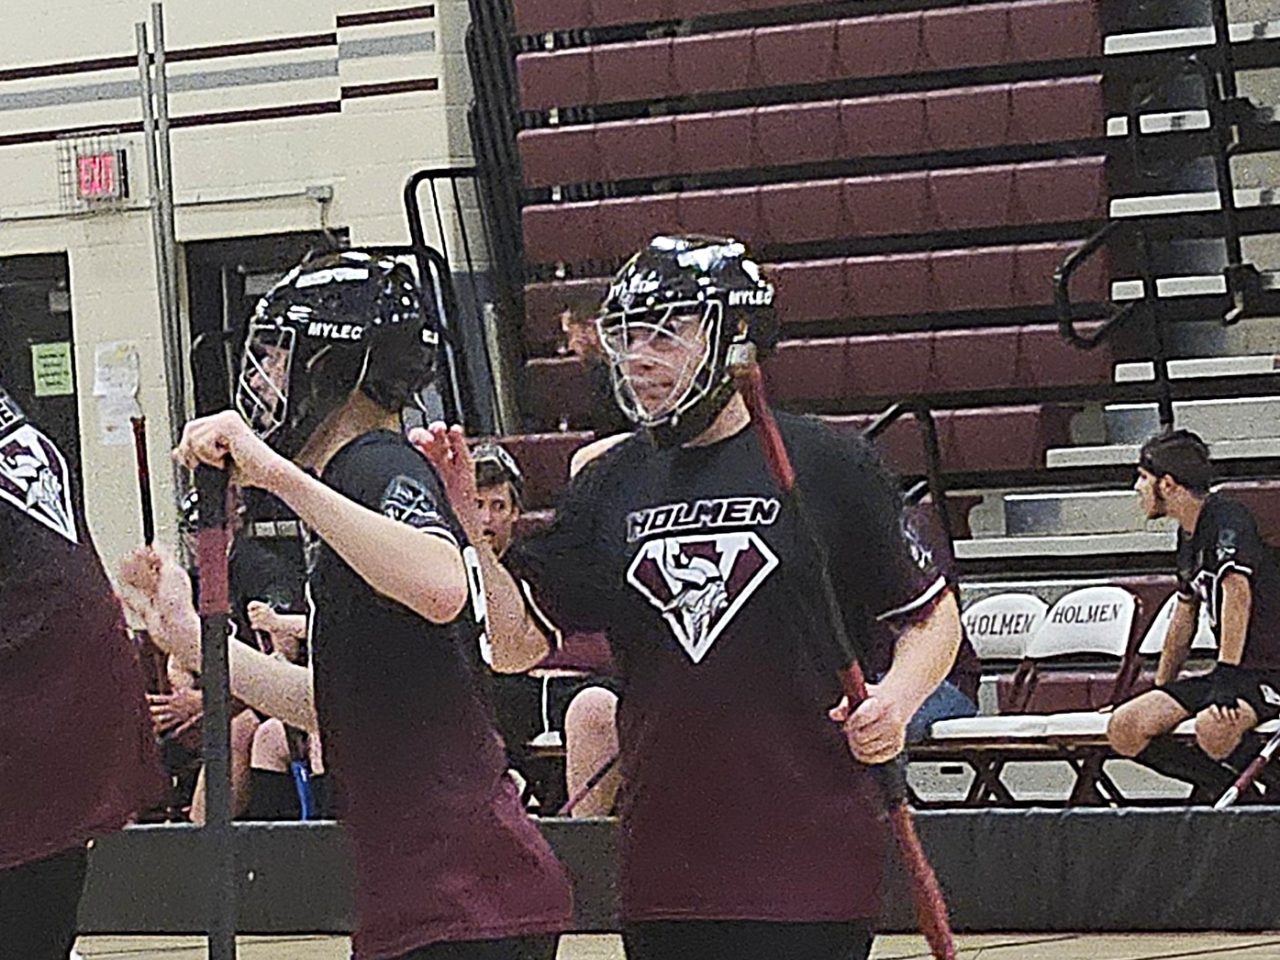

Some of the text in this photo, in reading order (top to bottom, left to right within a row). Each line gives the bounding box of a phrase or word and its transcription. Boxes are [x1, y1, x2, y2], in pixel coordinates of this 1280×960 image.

[80, 156, 113, 192] EXIT
[626, 497, 782, 543] HOLMEN
[966, 613, 1035, 636] HOLMEN
[1052, 603, 1123, 624] HOLMEN
